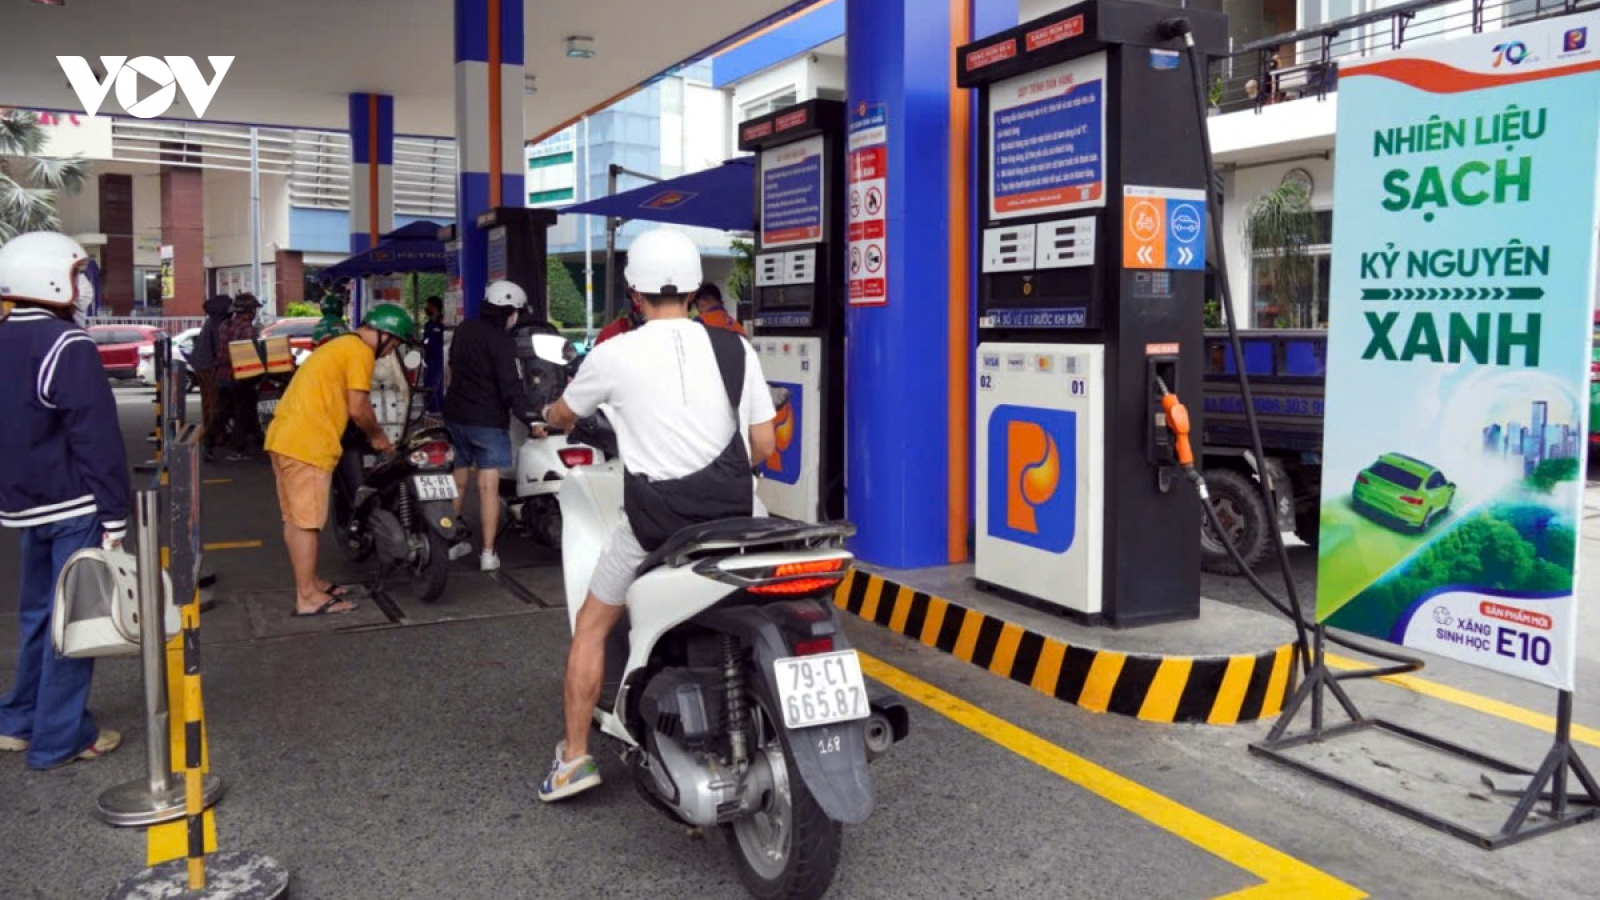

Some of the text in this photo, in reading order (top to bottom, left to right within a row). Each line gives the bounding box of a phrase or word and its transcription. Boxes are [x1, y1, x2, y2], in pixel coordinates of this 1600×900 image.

[1373, 104, 1547, 157] NHIÊN LIỆU
[1381, 156, 1532, 222] SẠCH
[1360, 238, 1550, 279] KỶ NGUYÊN
[1360, 311, 1542, 367] XANH
[980, 375, 992, 388] 02
[1071, 379, 1084, 395] 01
[1436, 627, 1491, 652] SINH HỌC
[1457, 617, 1492, 636] XĂNG
[1496, 626, 1552, 666] E10
[787, 656, 849, 691] 79-C1
[787, 685, 859, 724] 665.87
